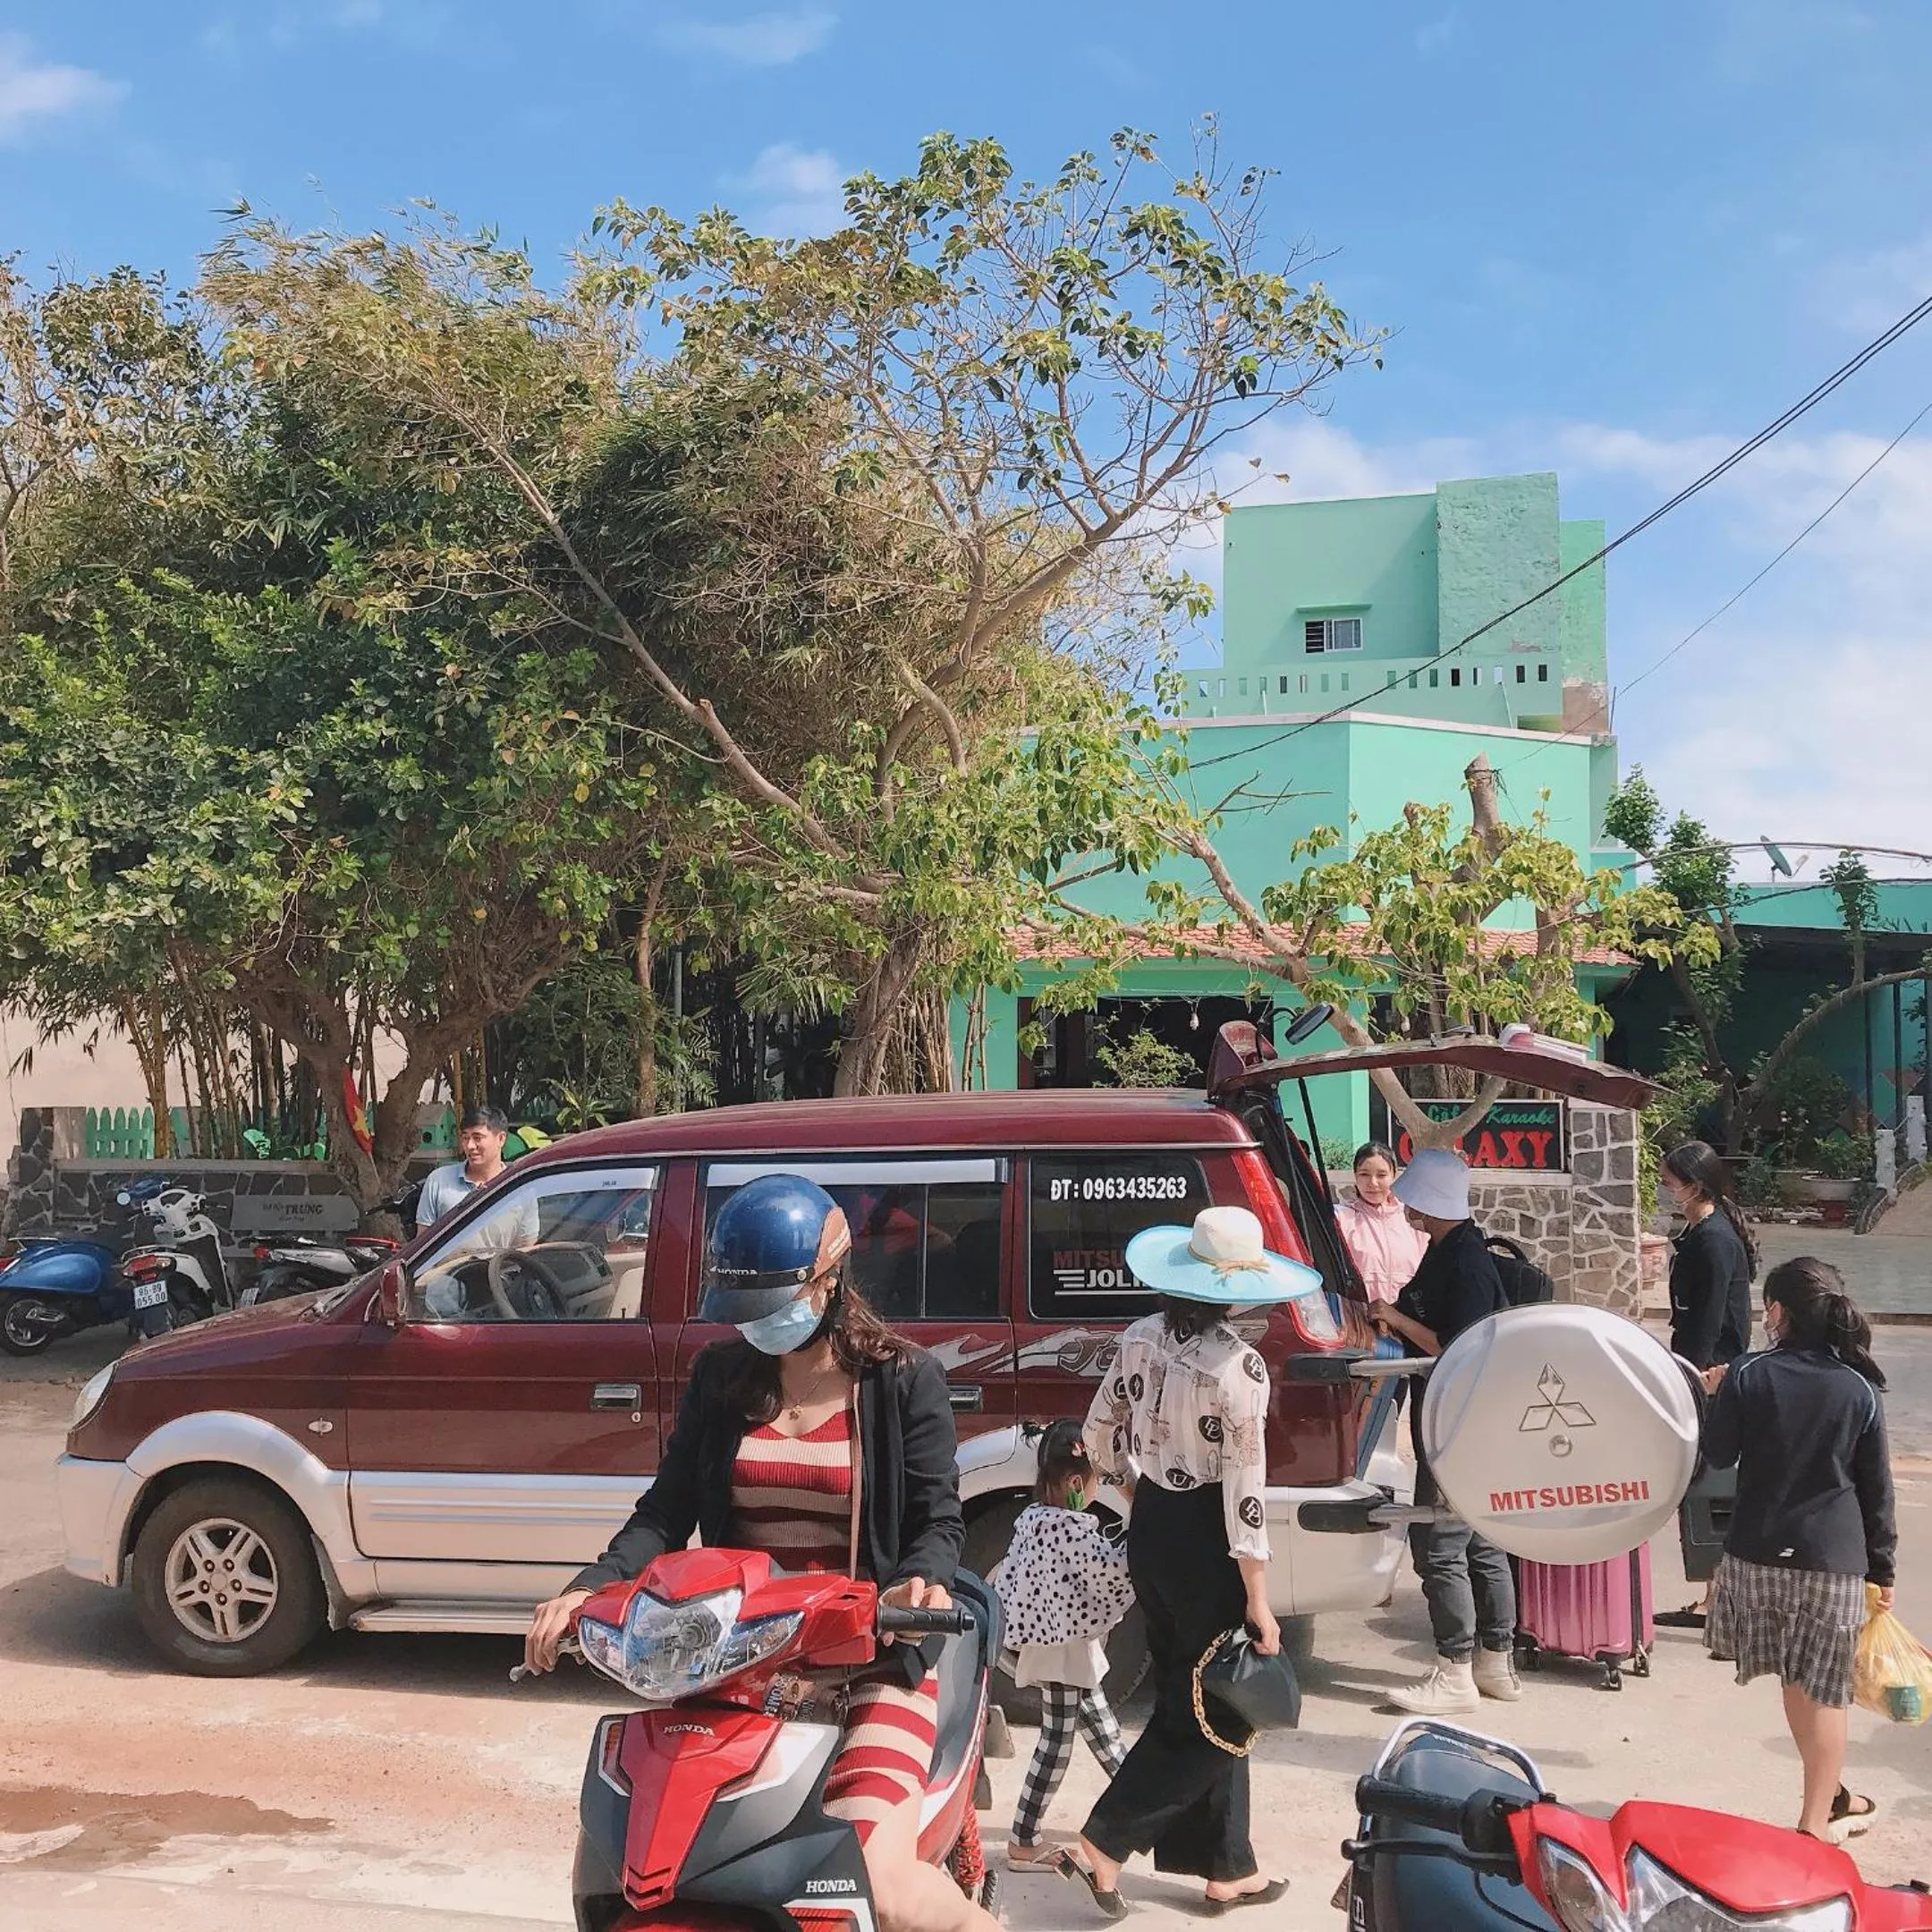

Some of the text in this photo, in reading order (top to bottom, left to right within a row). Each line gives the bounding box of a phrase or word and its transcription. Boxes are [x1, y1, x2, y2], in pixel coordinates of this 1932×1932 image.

[1489, 1480, 1650, 1512] MITSUBISHI
[664, 1724, 715, 1736] HONDA
[805, 1878, 857, 1893] HONDA
